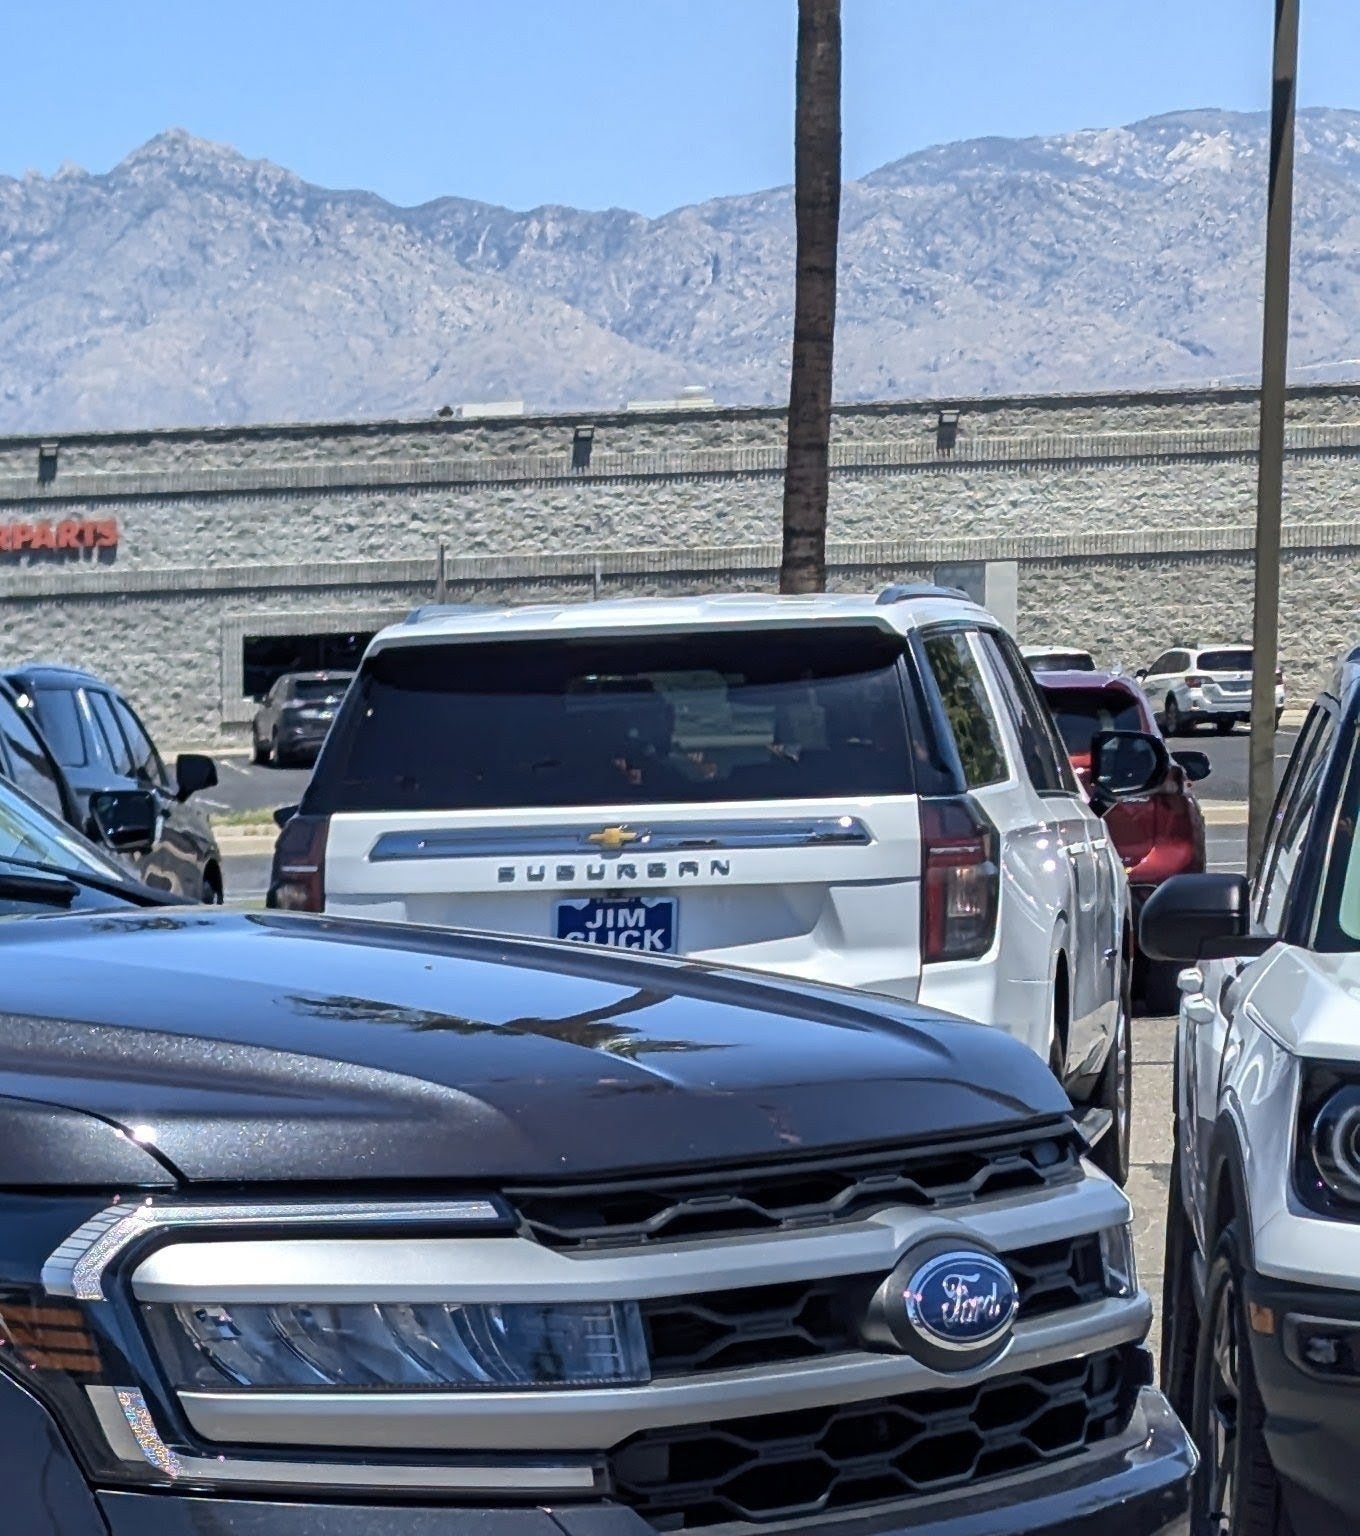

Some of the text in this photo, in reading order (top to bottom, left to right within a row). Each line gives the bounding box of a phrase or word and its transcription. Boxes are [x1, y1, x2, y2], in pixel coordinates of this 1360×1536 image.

[497, 859, 731, 883] SUBURBAN
[585, 907, 646, 929] JIM
[941, 1272, 1001, 1329] Ford
